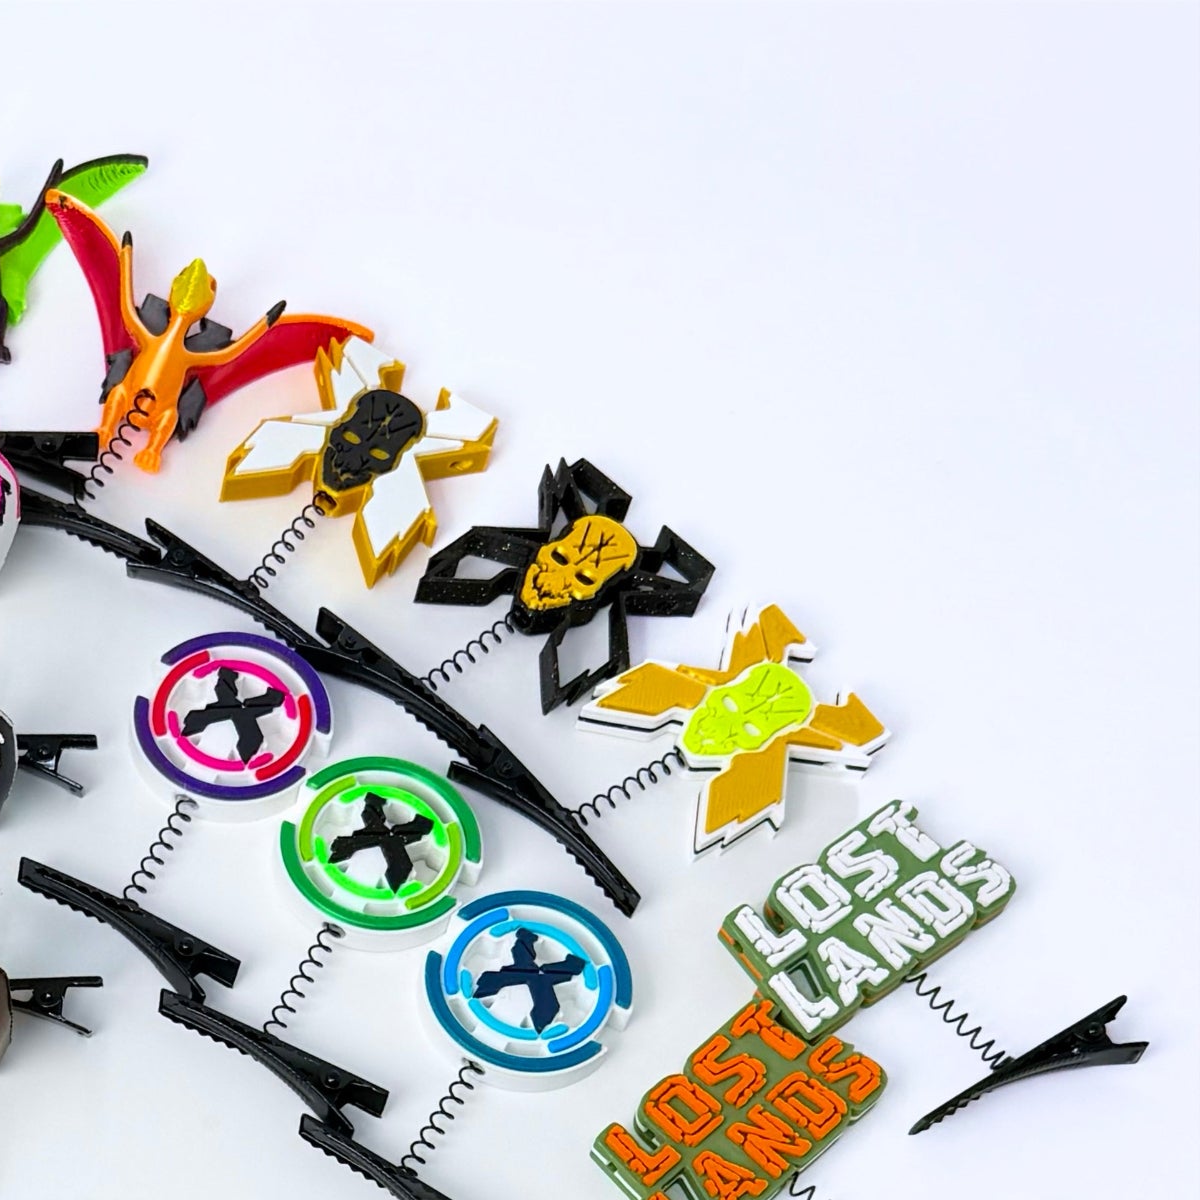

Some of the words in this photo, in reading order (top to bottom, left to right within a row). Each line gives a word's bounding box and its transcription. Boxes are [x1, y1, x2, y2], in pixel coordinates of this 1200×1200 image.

[734, 801, 941, 966] LOST
[768, 839, 1013, 1033] LANDS
[606, 1000, 806, 1187] LOST
